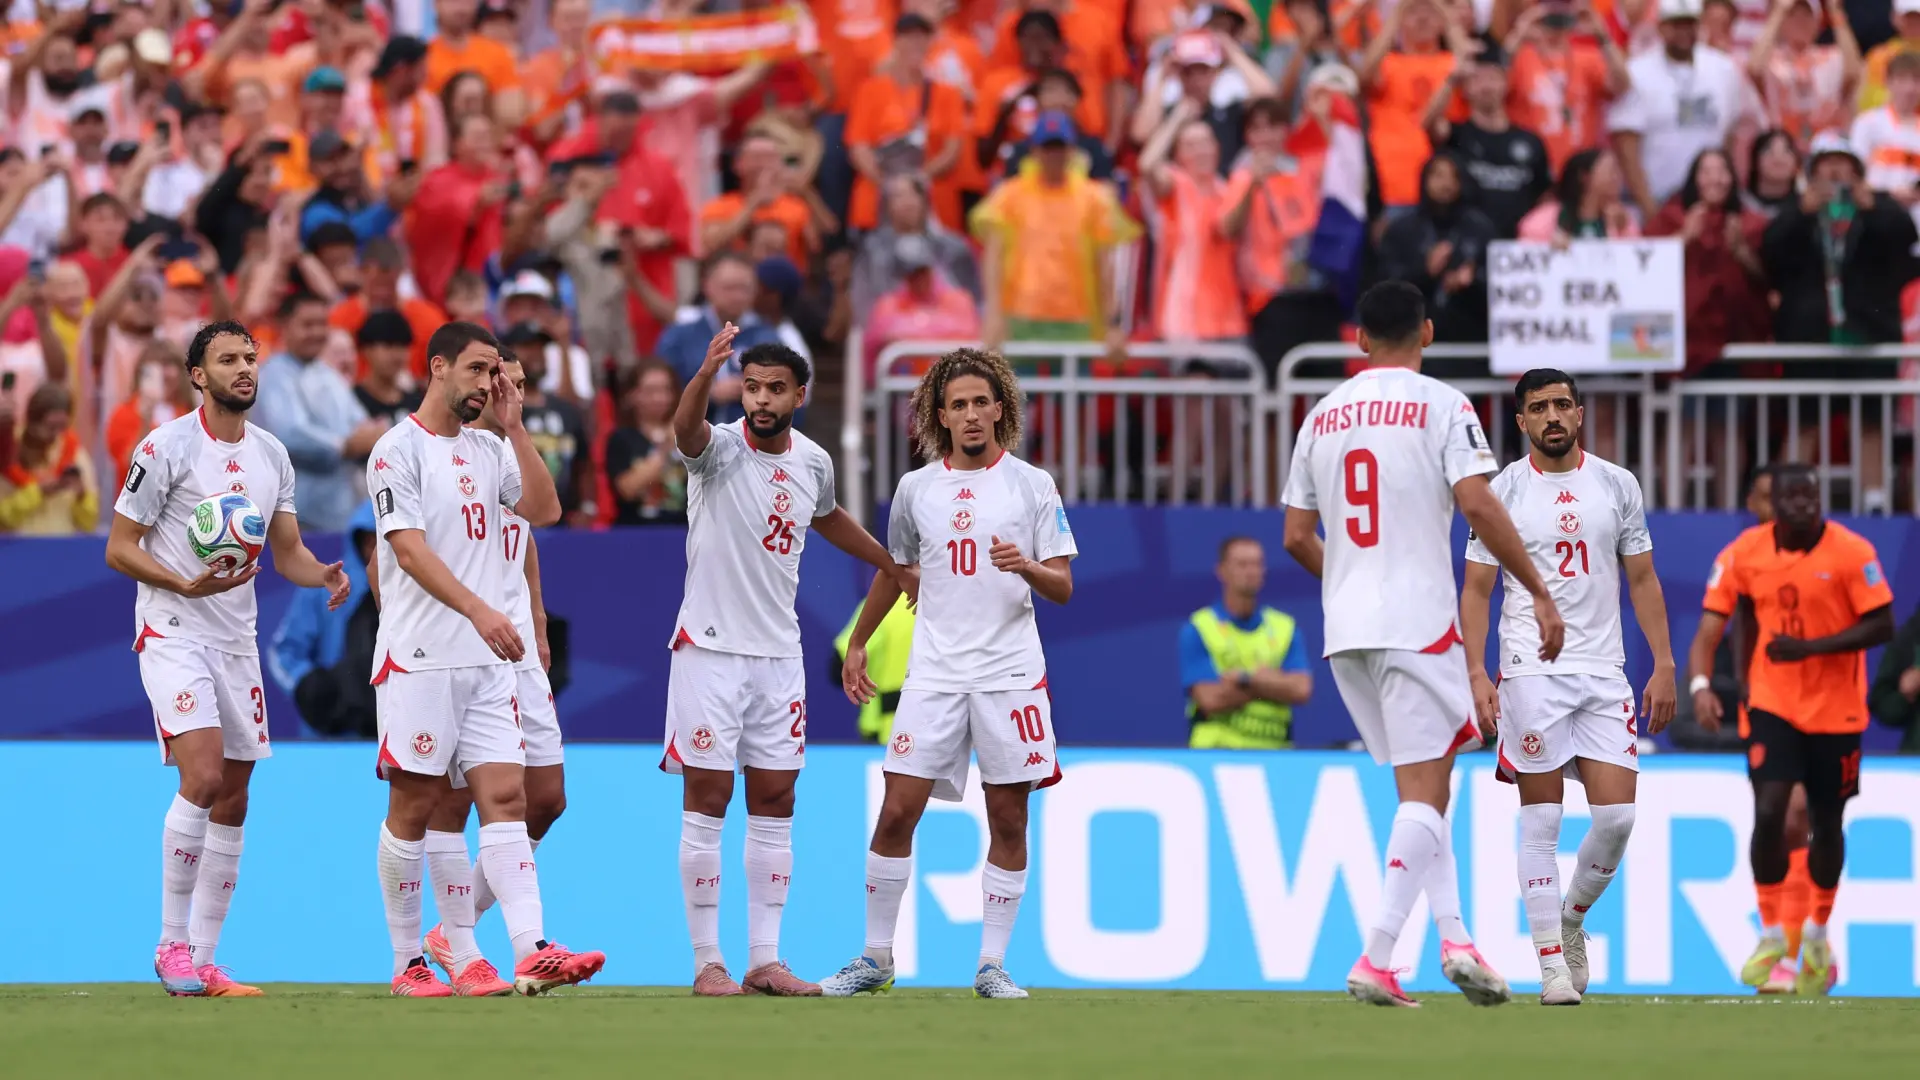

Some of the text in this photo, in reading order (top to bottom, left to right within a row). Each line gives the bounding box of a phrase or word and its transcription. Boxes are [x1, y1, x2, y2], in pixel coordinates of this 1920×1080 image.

[1492, 280, 1621, 309] NO ERA
[1493, 316, 1594, 345] PENAL
[1312, 401, 1429, 440] MASTOURI
[1344, 448, 1379, 548] 9
[461, 502, 486, 541] 13
[762, 514, 796, 555] 25
[502, 523, 521, 562] 17
[947, 538, 977, 577] 10
[1555, 539, 1589, 578] 21
[250, 686, 264, 725] 3
[1010, 704, 1045, 744] 10
[174, 848, 198, 867] FTF
[447, 884, 471, 896] FTF
[695, 874, 720, 888] FTF
[988, 894, 1010, 904] FTF
[1528, 877, 1553, 889] FTF
